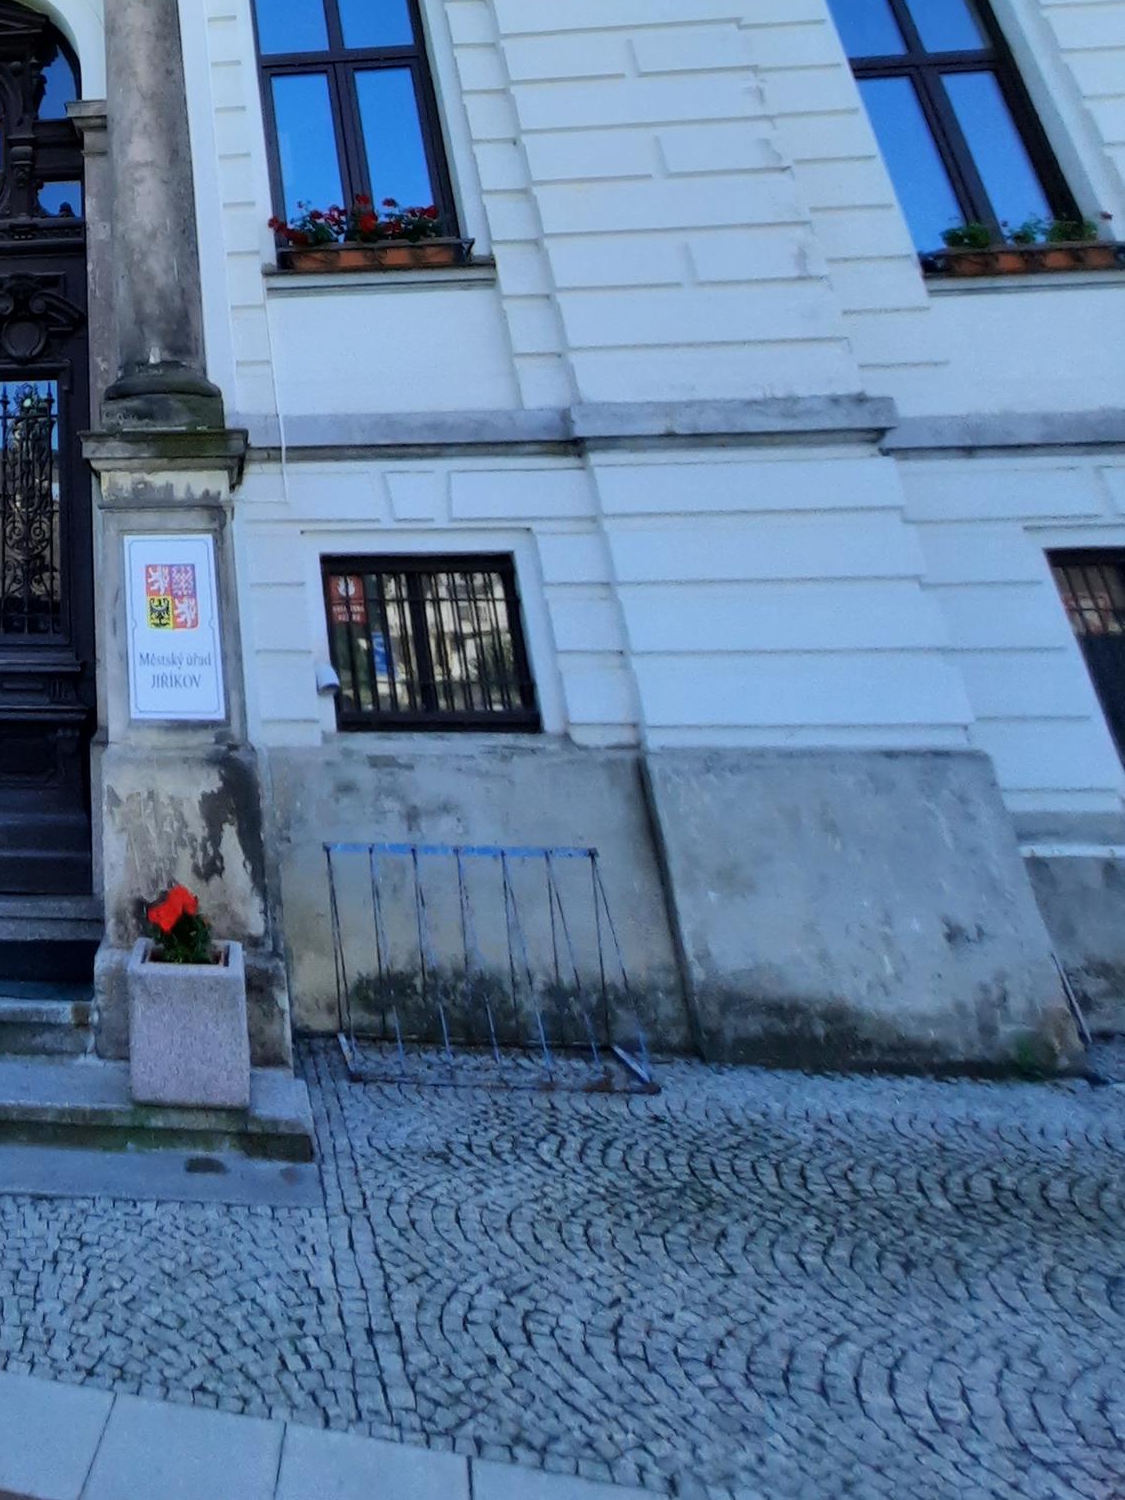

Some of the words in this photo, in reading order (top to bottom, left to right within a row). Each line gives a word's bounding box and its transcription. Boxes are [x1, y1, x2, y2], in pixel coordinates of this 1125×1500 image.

[139, 651, 184, 670] Městský
[186, 652, 211, 667] úřad
[150, 673, 202, 689] JIŘÍKOV
